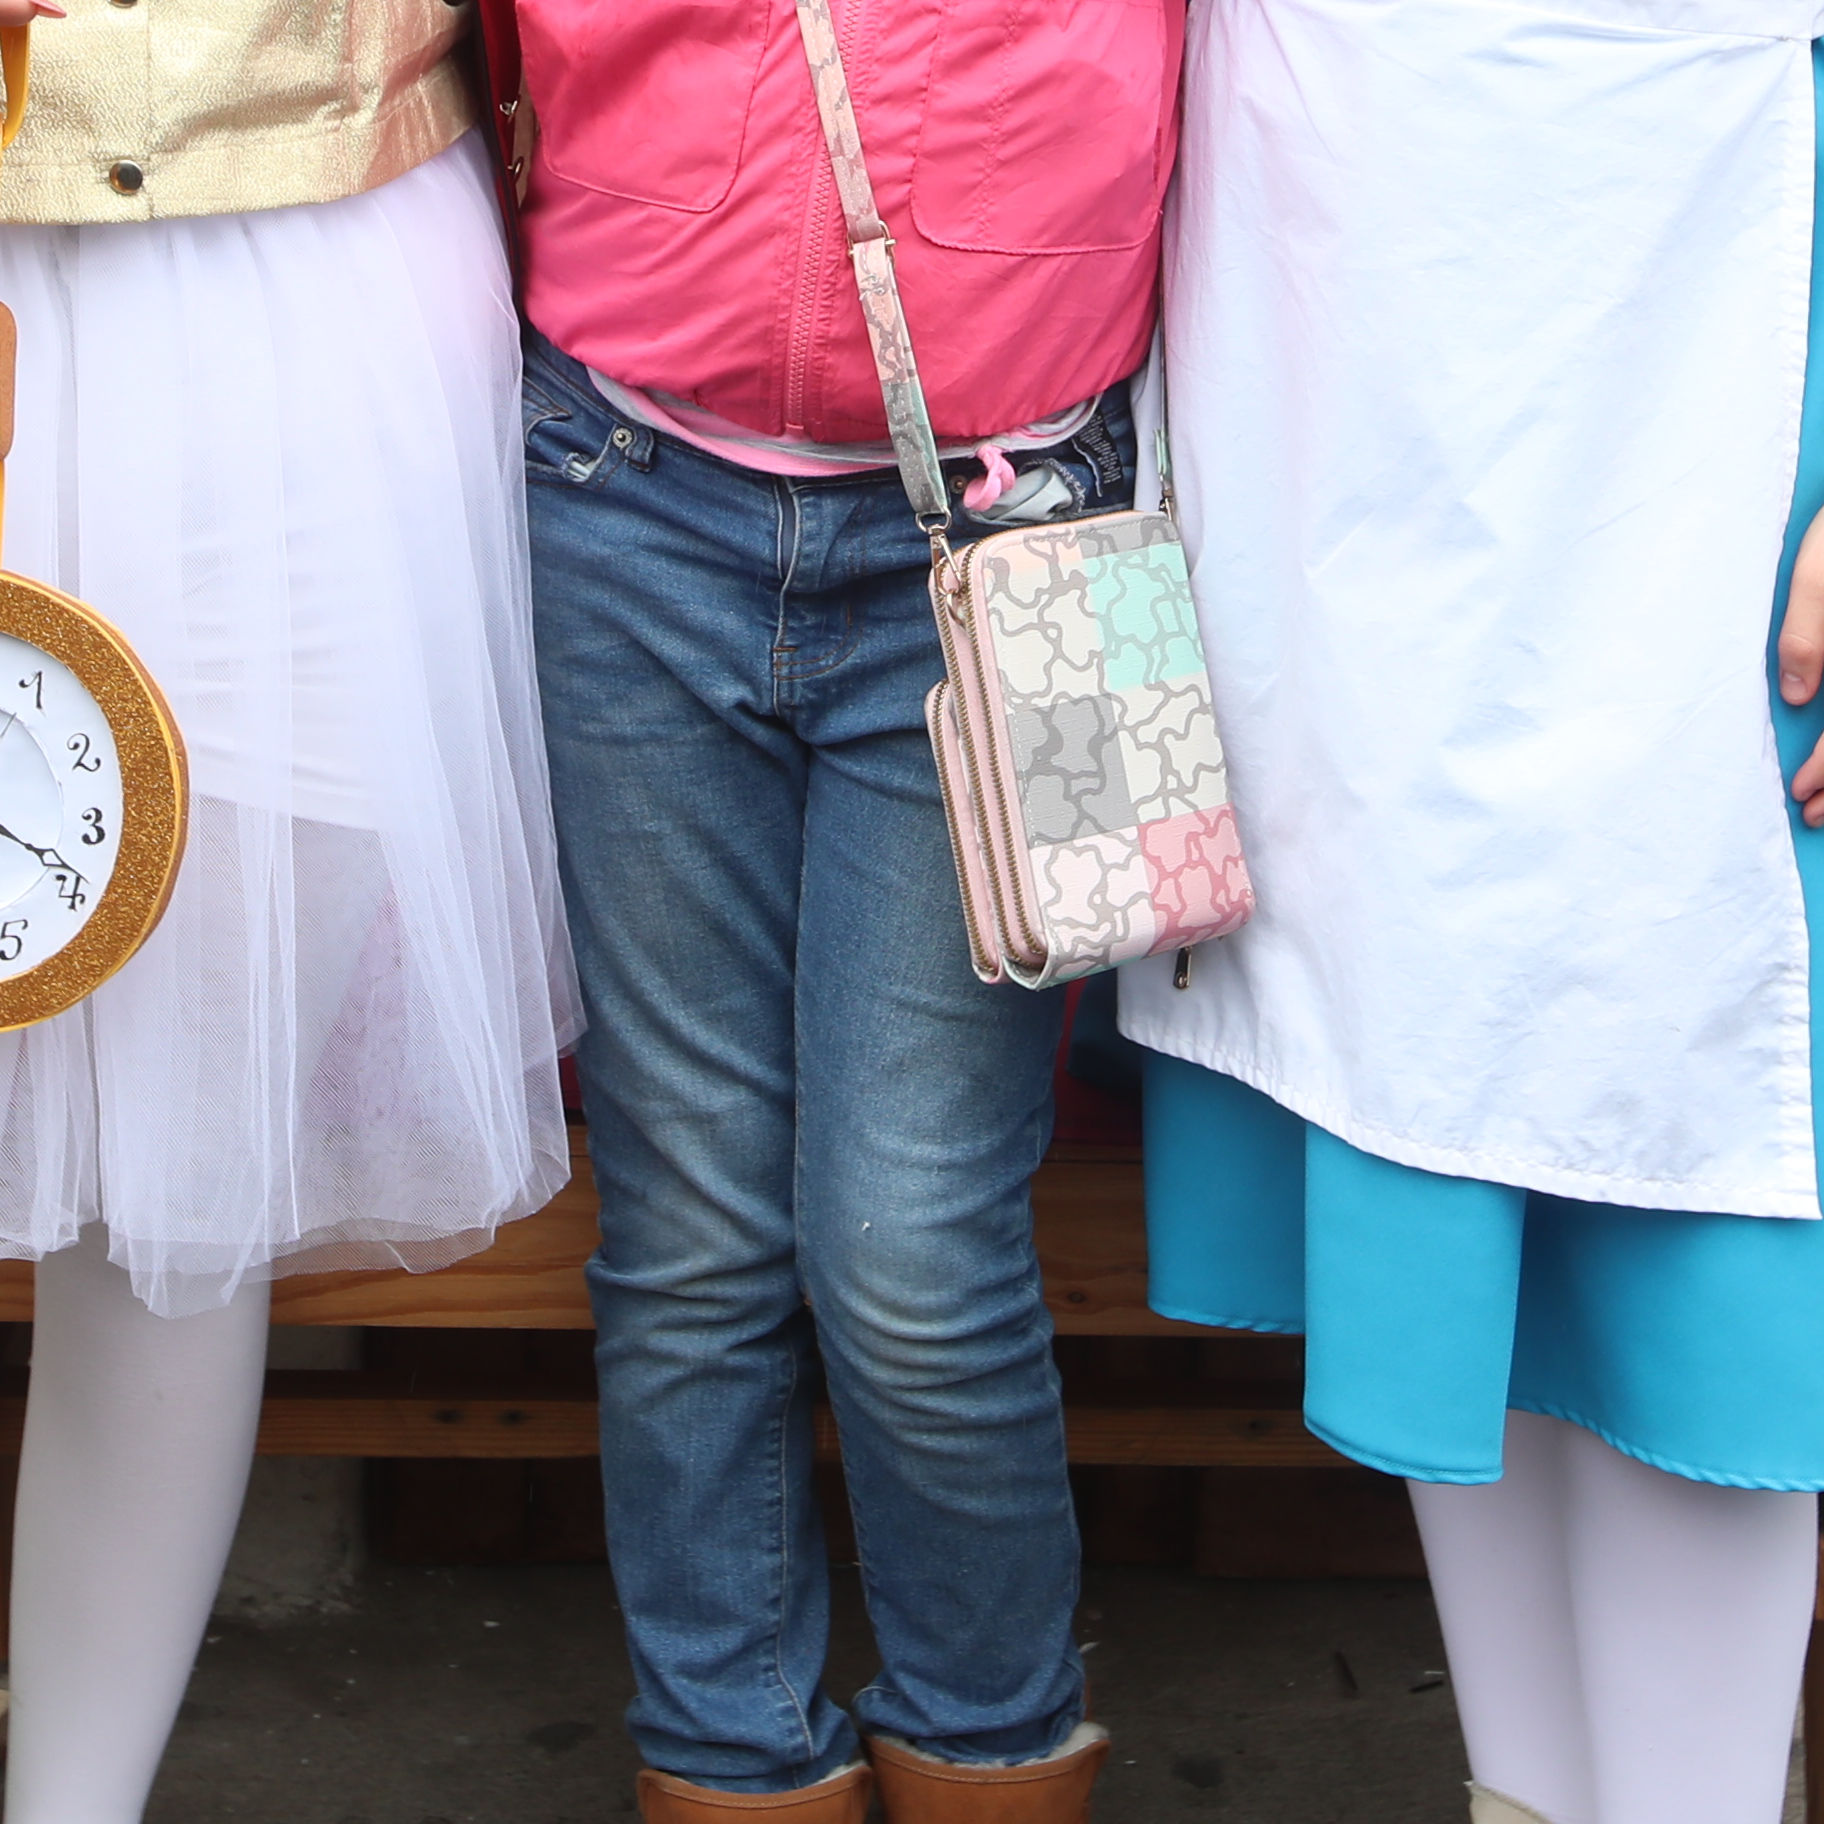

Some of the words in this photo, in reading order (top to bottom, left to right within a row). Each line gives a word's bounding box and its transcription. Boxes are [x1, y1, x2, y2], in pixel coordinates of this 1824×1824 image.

[19, 671, 42, 709] 1
[67, 733, 101, 772] 2
[81, 807, 105, 845] 3
[54, 874, 85, 911] 4
